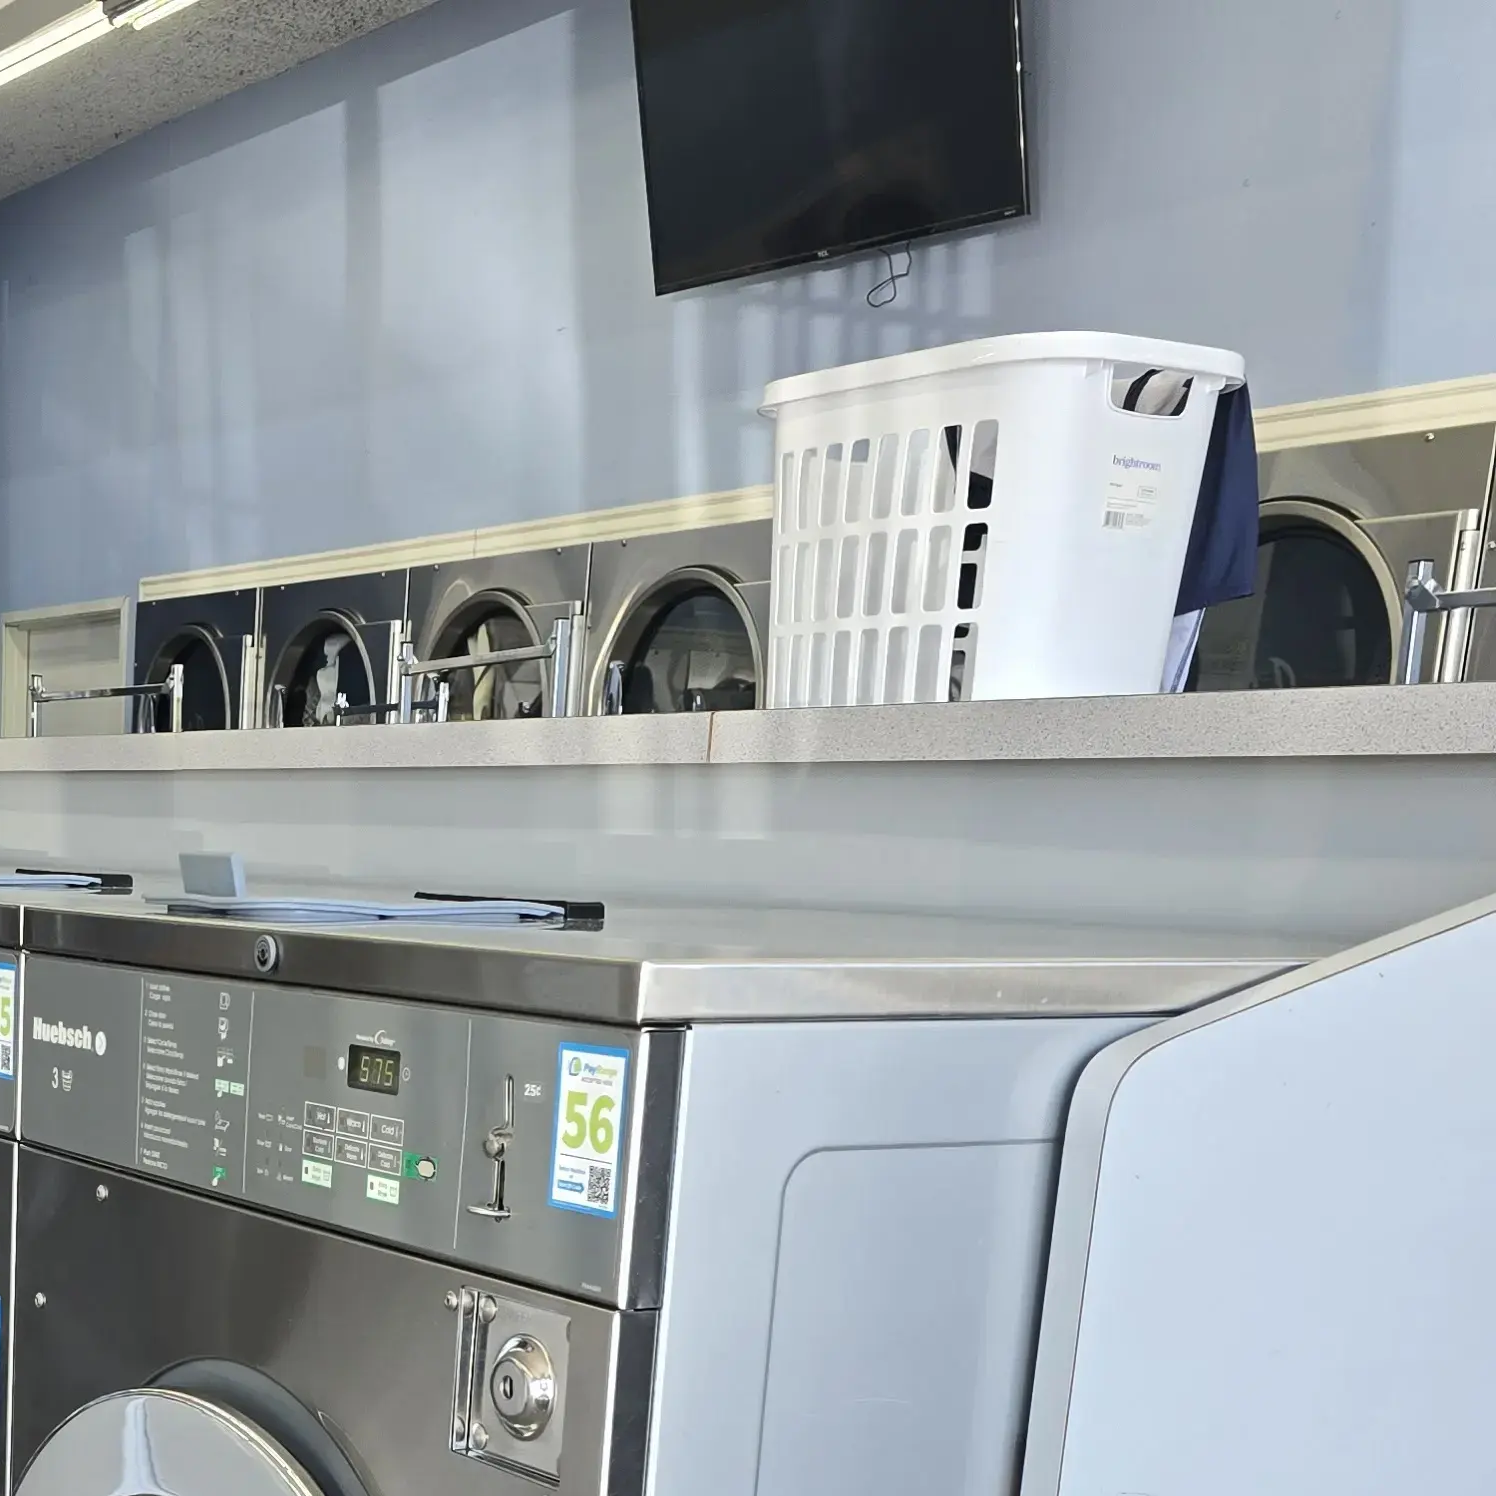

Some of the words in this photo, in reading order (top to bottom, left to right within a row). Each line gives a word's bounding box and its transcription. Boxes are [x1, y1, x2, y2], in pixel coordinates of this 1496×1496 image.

[1112, 454, 1161, 472] brightroom
[32, 1016, 92, 1050] Huebsch
[51, 1066, 59, 1088] 3
[360, 1055, 394, 1087] 575
[381, 1124, 395, 1135] Cold
[562, 1090, 615, 1154] 56
